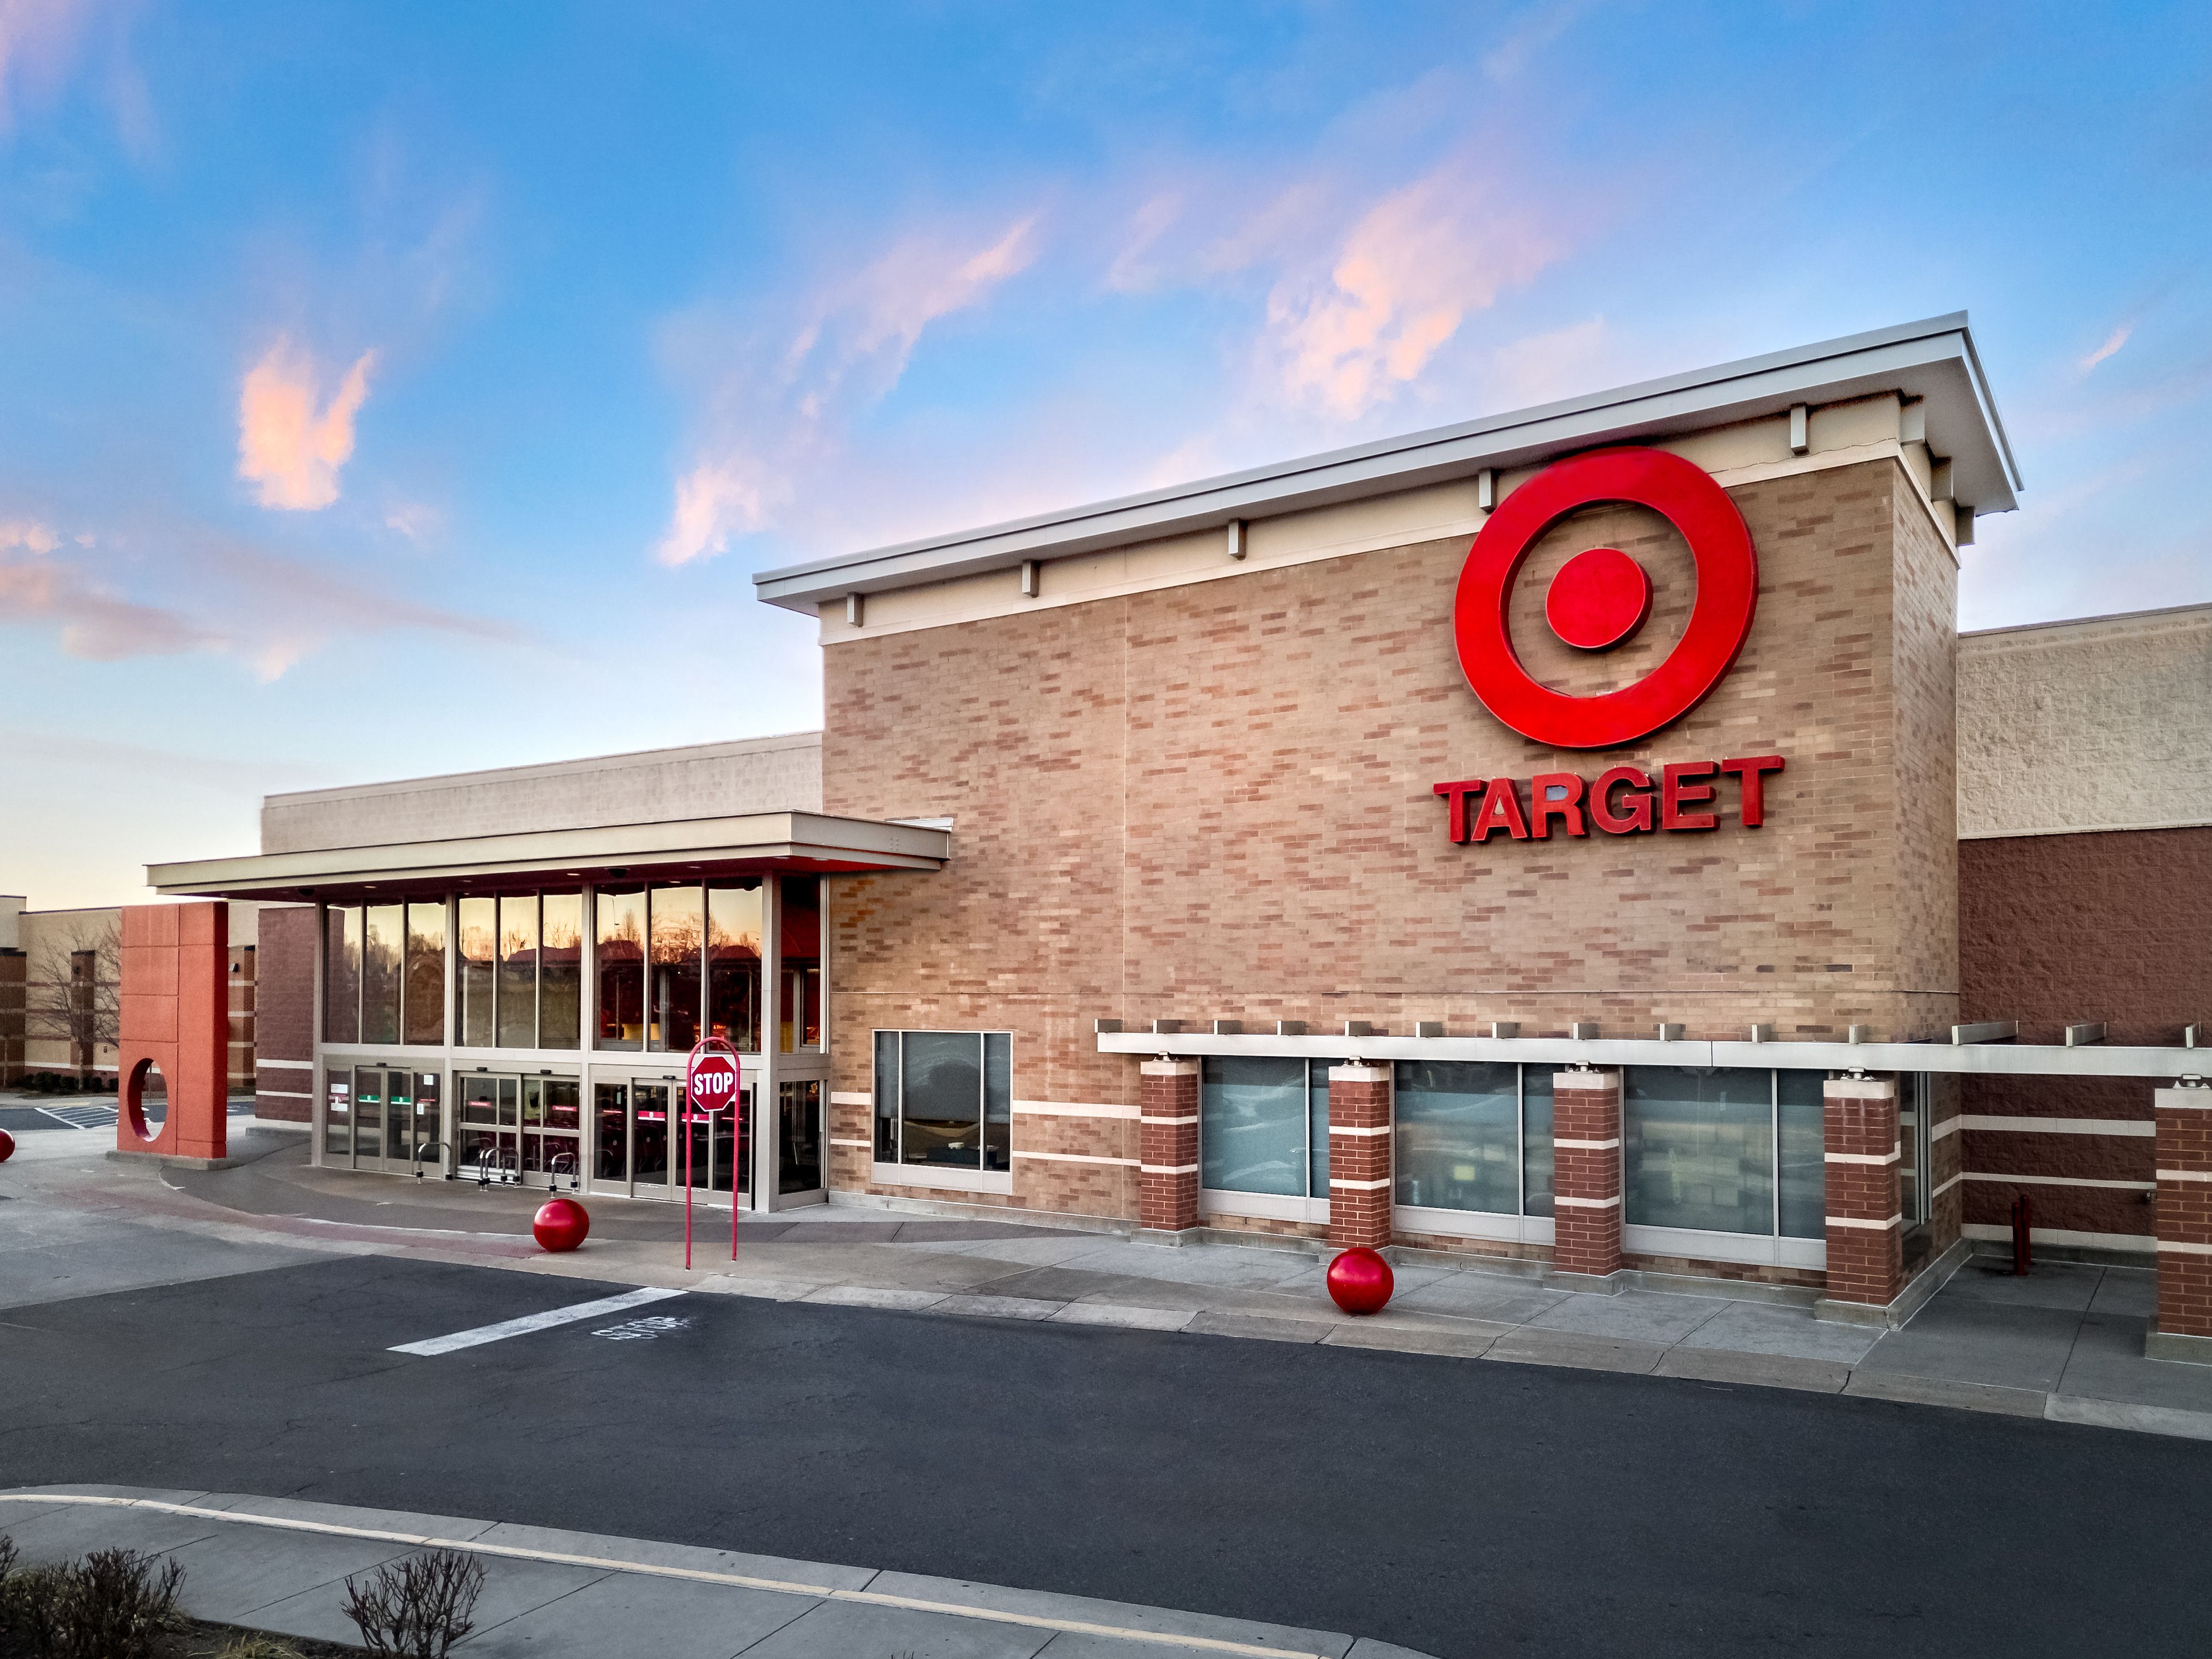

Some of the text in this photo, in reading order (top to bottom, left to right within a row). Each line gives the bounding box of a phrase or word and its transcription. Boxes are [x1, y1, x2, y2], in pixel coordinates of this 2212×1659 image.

[1433, 755, 1786, 843] TARGET
[694, 1072, 733, 1096] STOP
[591, 1317, 684, 1340] STOP
